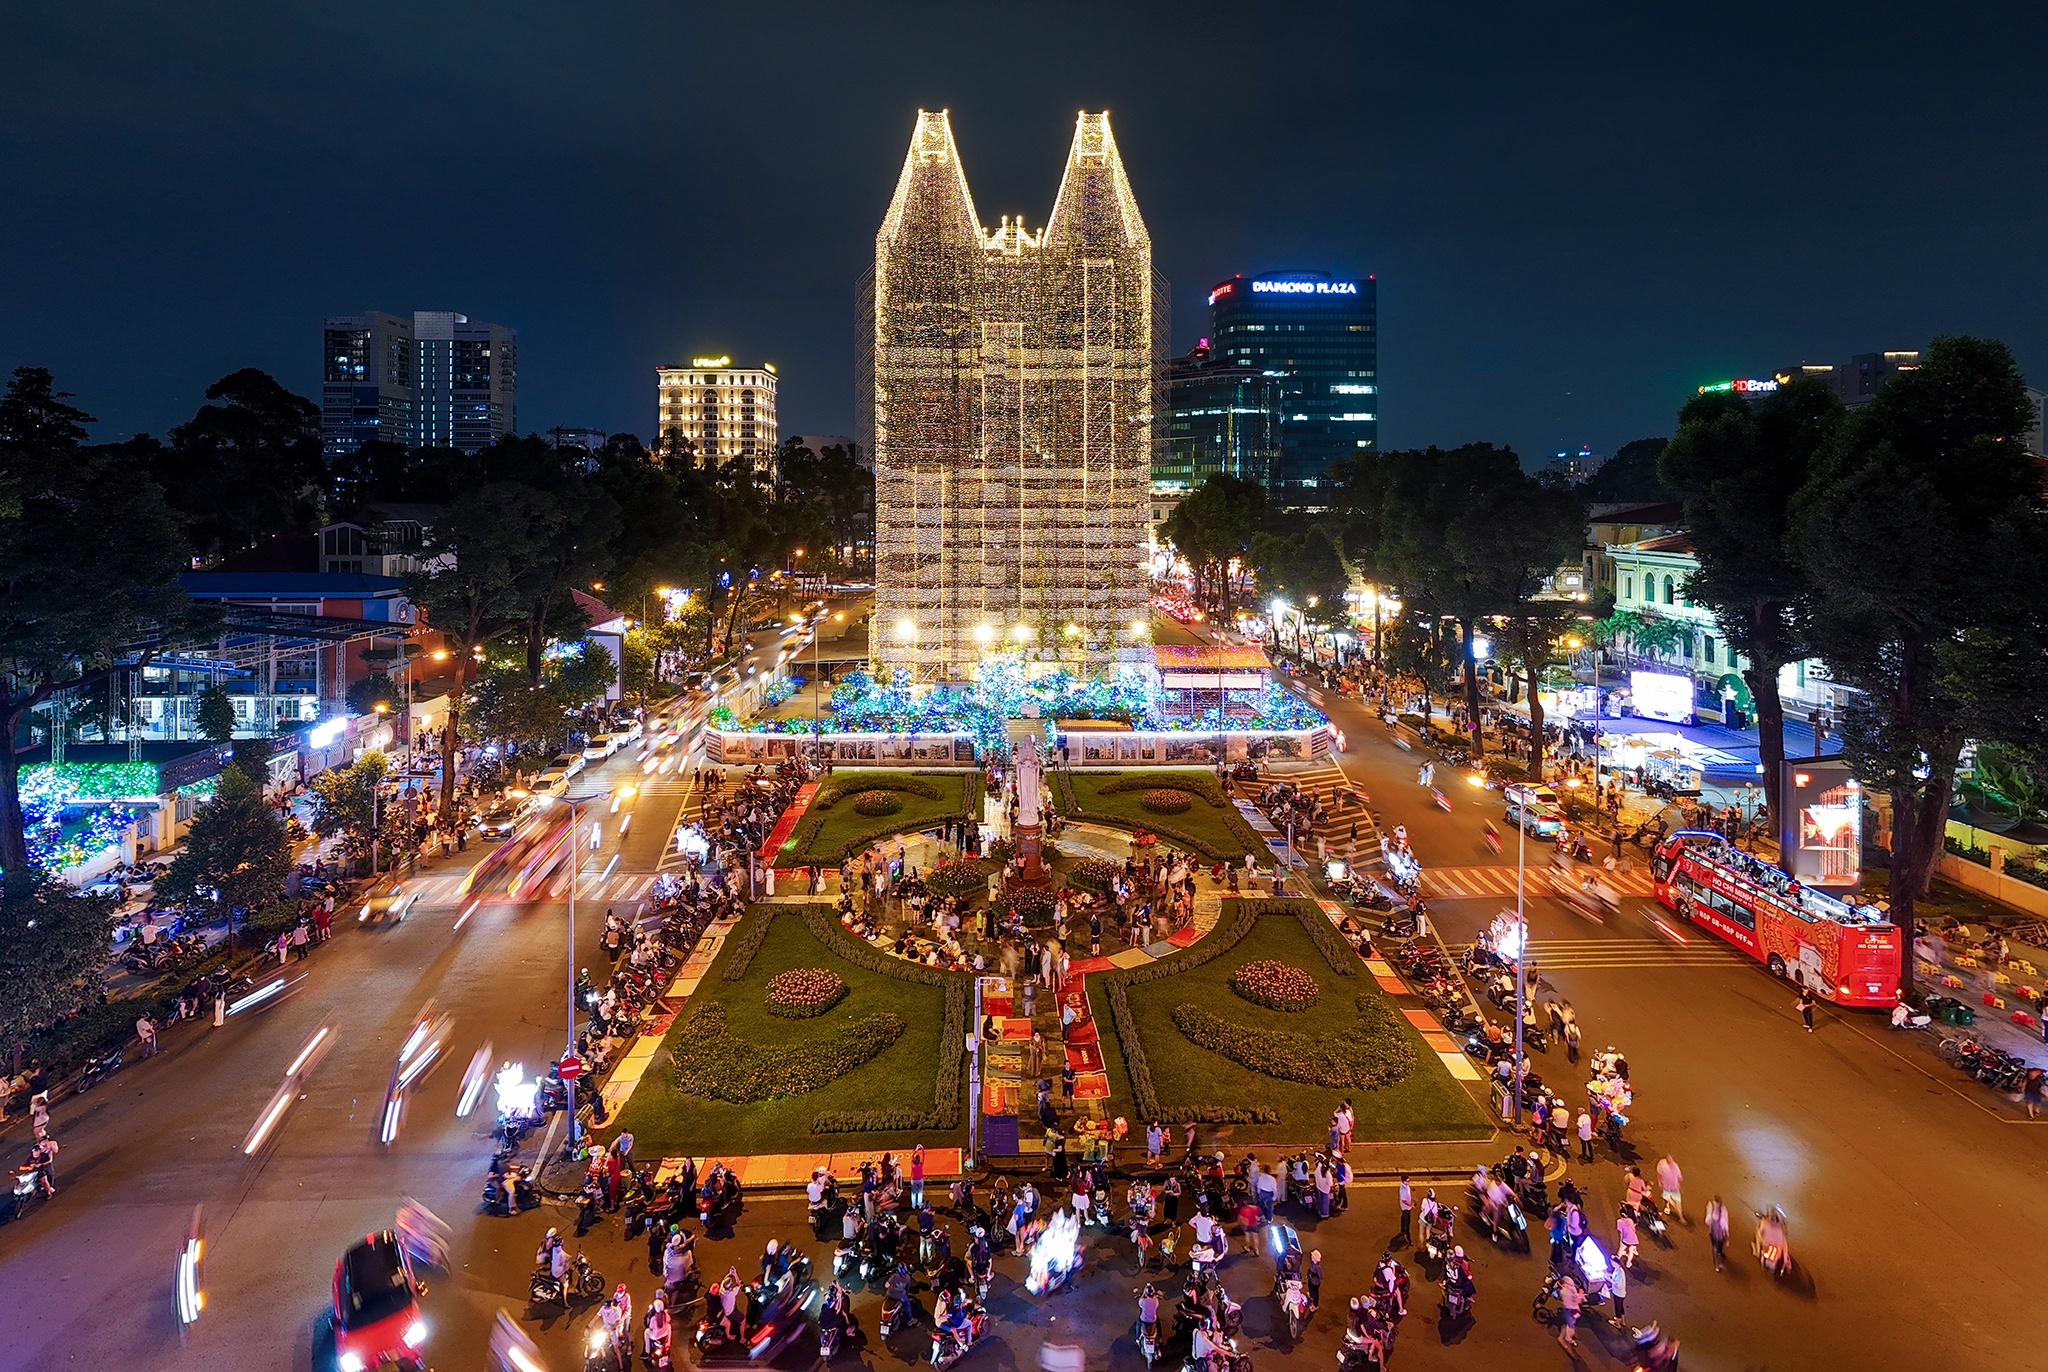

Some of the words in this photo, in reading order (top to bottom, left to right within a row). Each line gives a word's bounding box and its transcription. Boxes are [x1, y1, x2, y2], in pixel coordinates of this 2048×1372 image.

[1252, 281, 1315, 294] DIAMOND
[1316, 282, 1356, 294] PLAZA
[1732, 380, 1777, 391] HDBank
